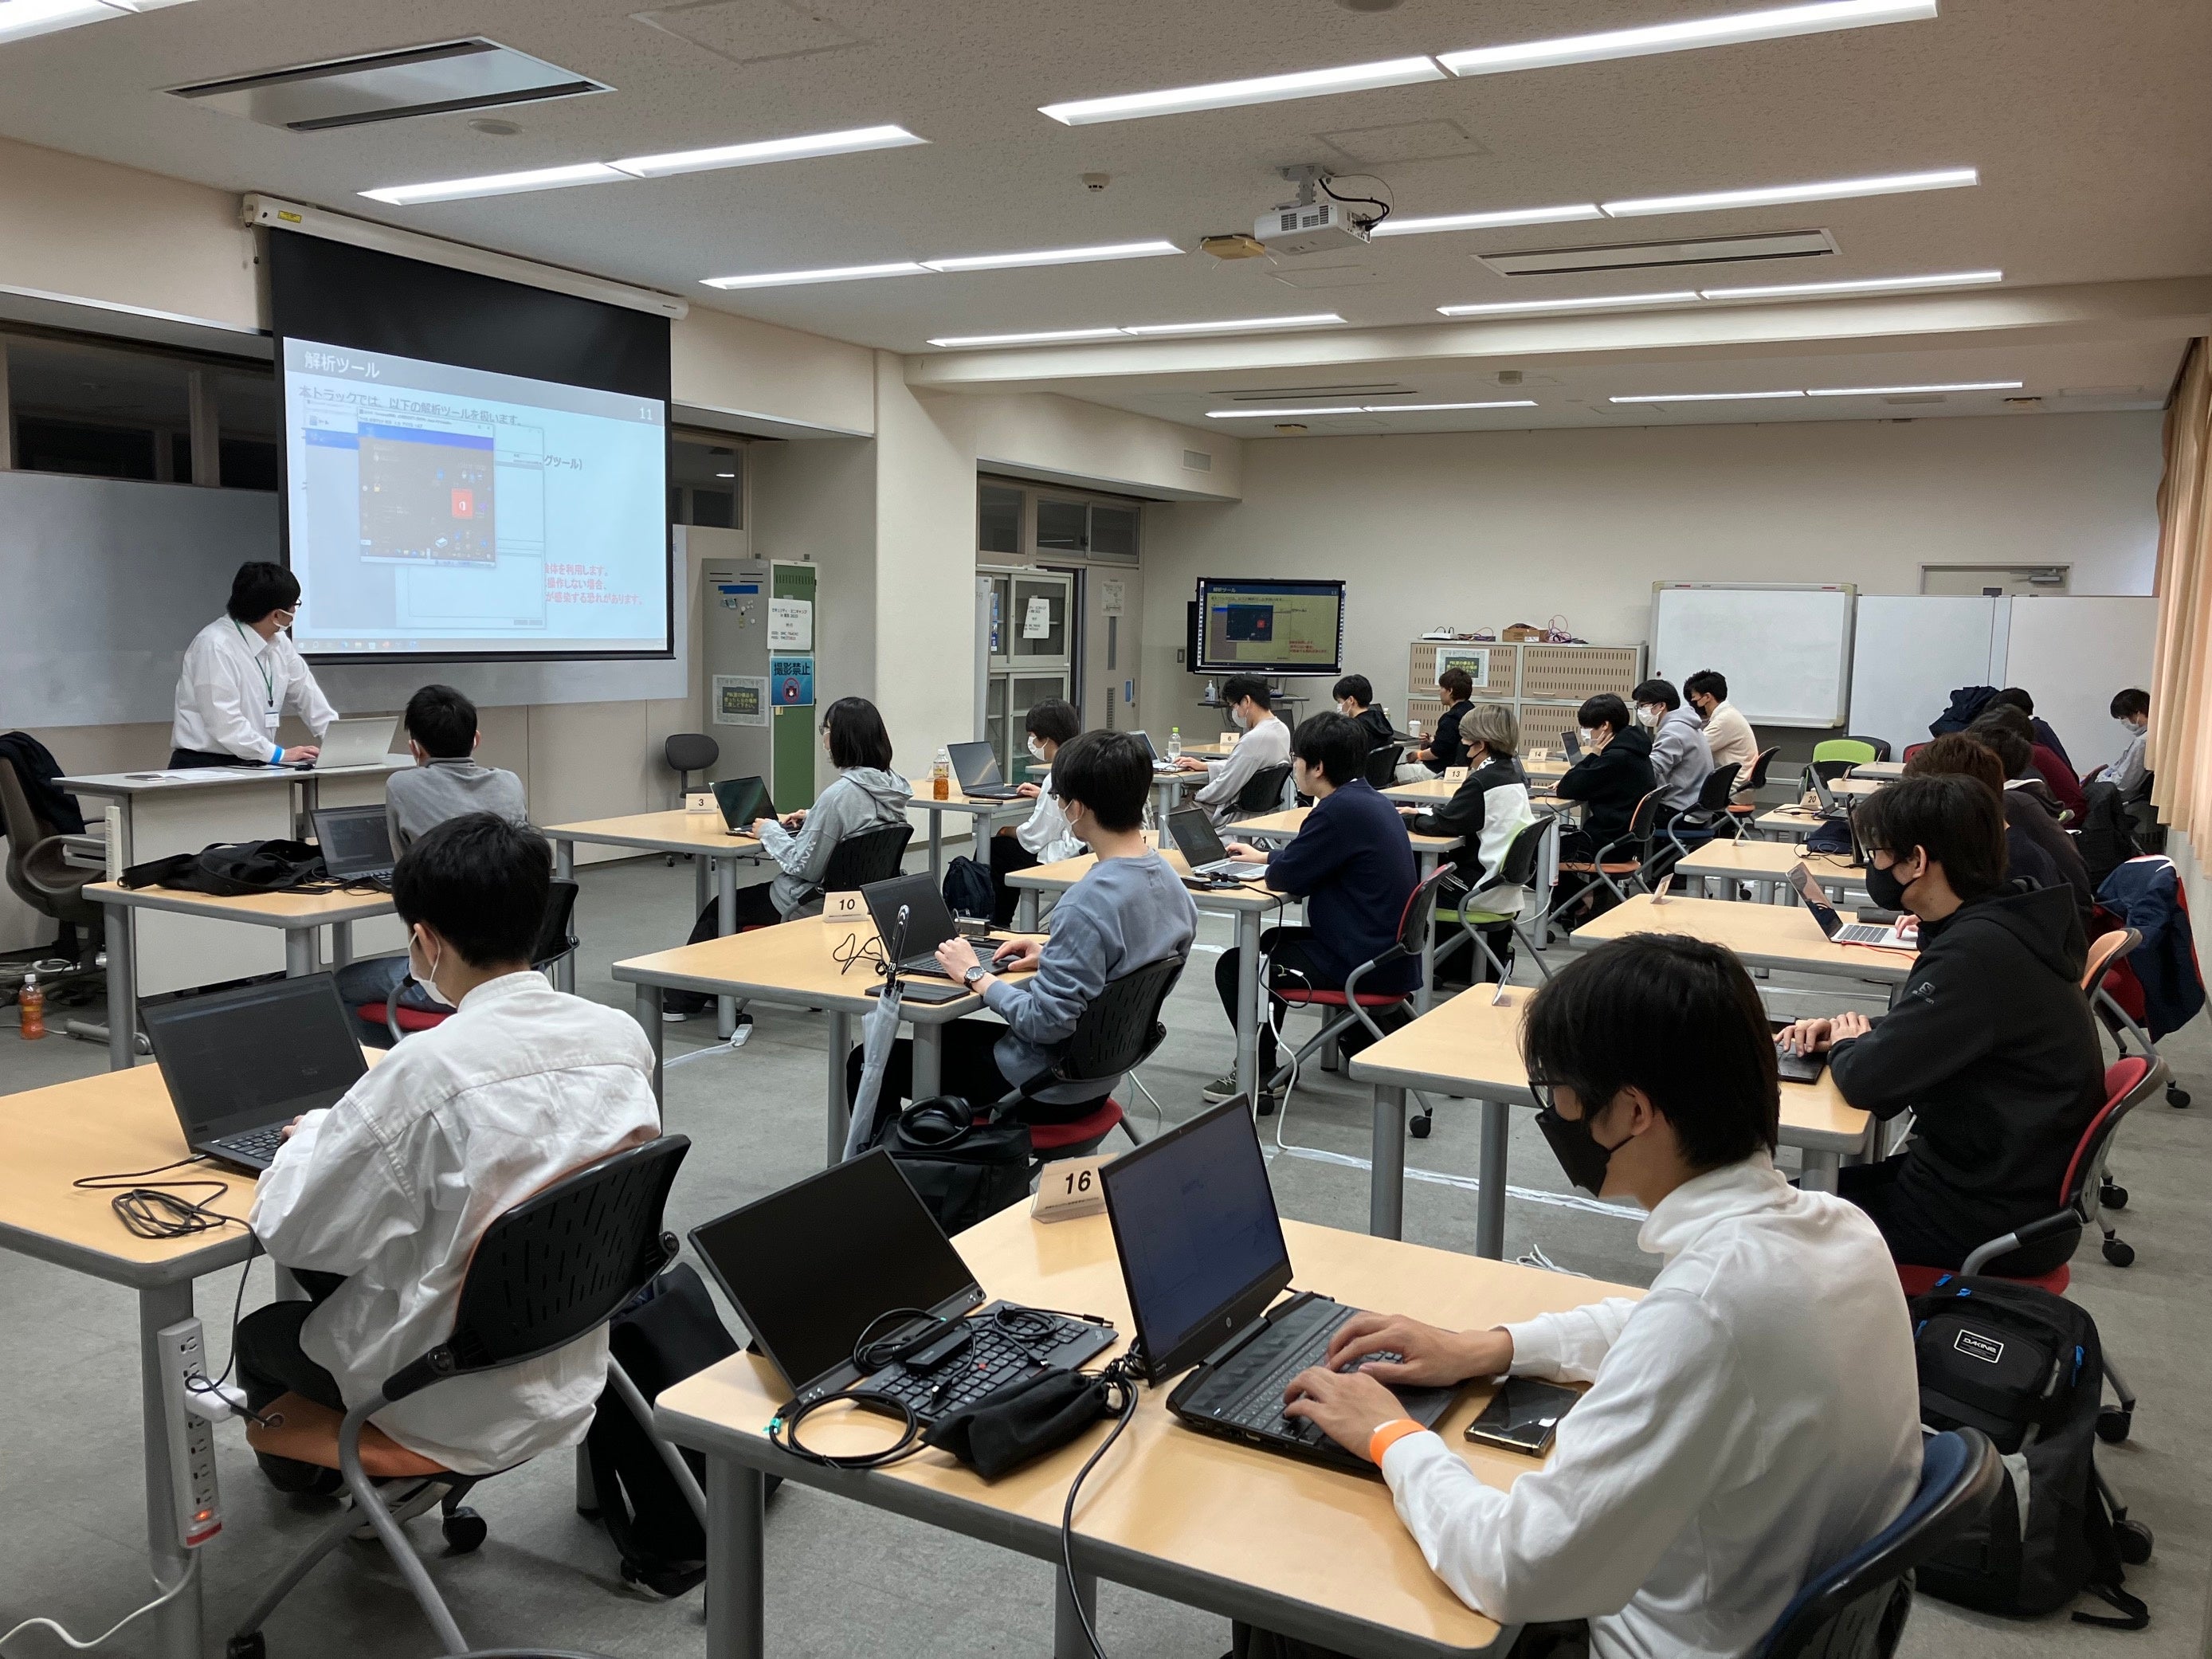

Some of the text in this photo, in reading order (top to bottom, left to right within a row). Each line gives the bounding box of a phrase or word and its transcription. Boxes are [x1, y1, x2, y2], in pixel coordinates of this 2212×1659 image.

[304, 351, 380, 378] 解析ツール
[639, 407, 653, 421] 11
[774, 662, 810, 676] 撮影禁止
[839, 898, 855, 911] 10
[888, 962, 896, 971] 70
[1065, 1170, 1092, 1195] 16
[1962, 1337, 1997, 1354] DAKINE
